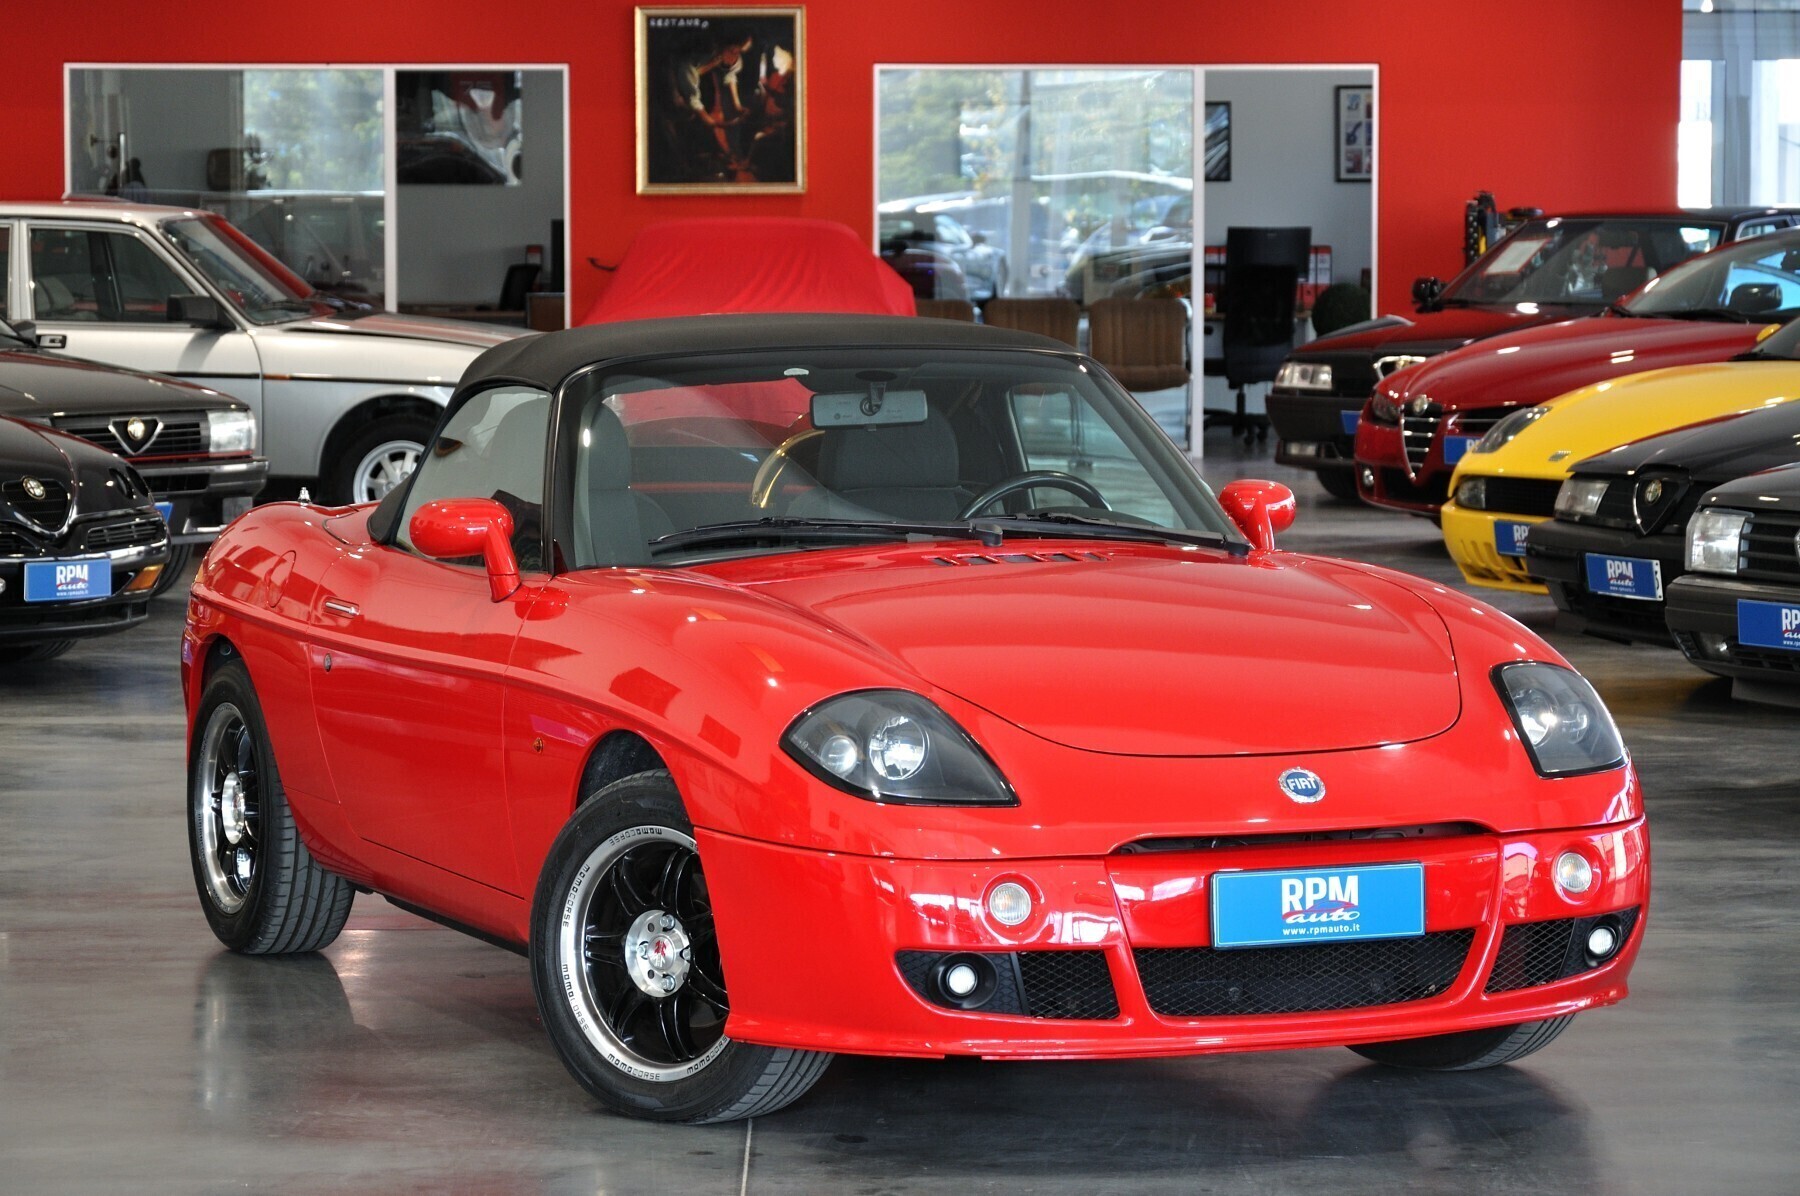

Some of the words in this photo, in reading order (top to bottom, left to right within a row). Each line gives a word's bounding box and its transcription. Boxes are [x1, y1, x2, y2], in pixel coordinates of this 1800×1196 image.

[1513, 524, 1529, 541] RP
[56, 564, 88, 585] RPM
[1606, 559, 1634, 579] RPM
[1781, 608, 1800, 631] RP
[1286, 777, 1317, 790] FIAT
[1281, 875, 1359, 916] RPM
[1285, 907, 1360, 924] auto
[1282, 923, 1361, 936] www.rpmauto.it
